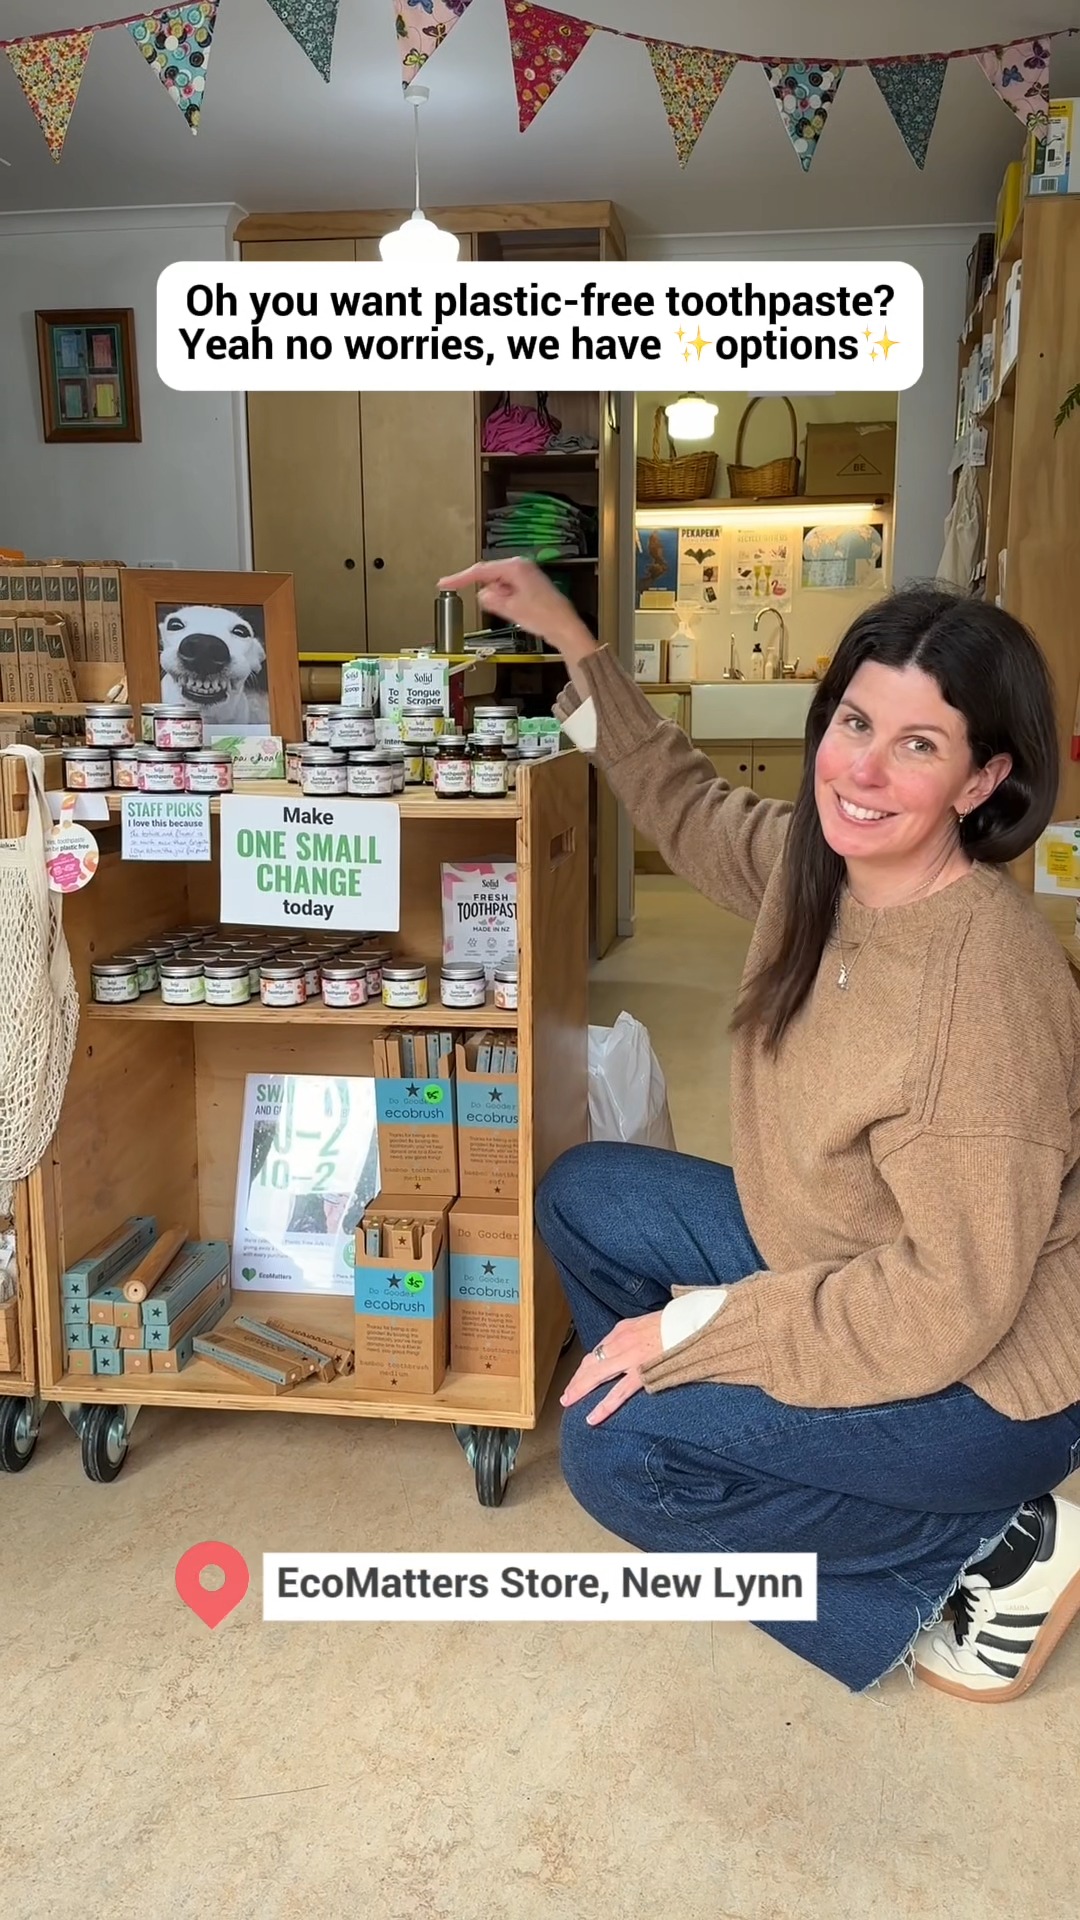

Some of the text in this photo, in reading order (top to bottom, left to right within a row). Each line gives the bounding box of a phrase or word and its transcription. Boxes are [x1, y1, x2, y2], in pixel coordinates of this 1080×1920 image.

[853, 463, 866, 472] BE
[682, 529, 720, 538] PEKAPEKA
[414, 673, 433, 685] Solid
[407, 688, 441, 698] Tongue
[407, 696, 441, 706] Scraper
[128, 802, 203, 817] STAFF PICKS
[283, 806, 334, 825] Make
[237, 828, 382, 864] ONE SMALL
[257, 863, 362, 896] CHANGE
[482, 879, 499, 890] Solid
[283, 899, 334, 920] today
[255, 1106, 271, 1115] AND
[385, 1108, 444, 1119] ecobrush
[457, 1229, 471, 1238] Do
[259, 1272, 292, 1280] EcoMatters
[464, 1274, 510, 1284] Do Gooder
[407, 1276, 423, 1288] $5
[384, 1289, 415, 1297] Gooder
[459, 1285, 519, 1298] ecobrush
[364, 1299, 425, 1312] ecobrush
